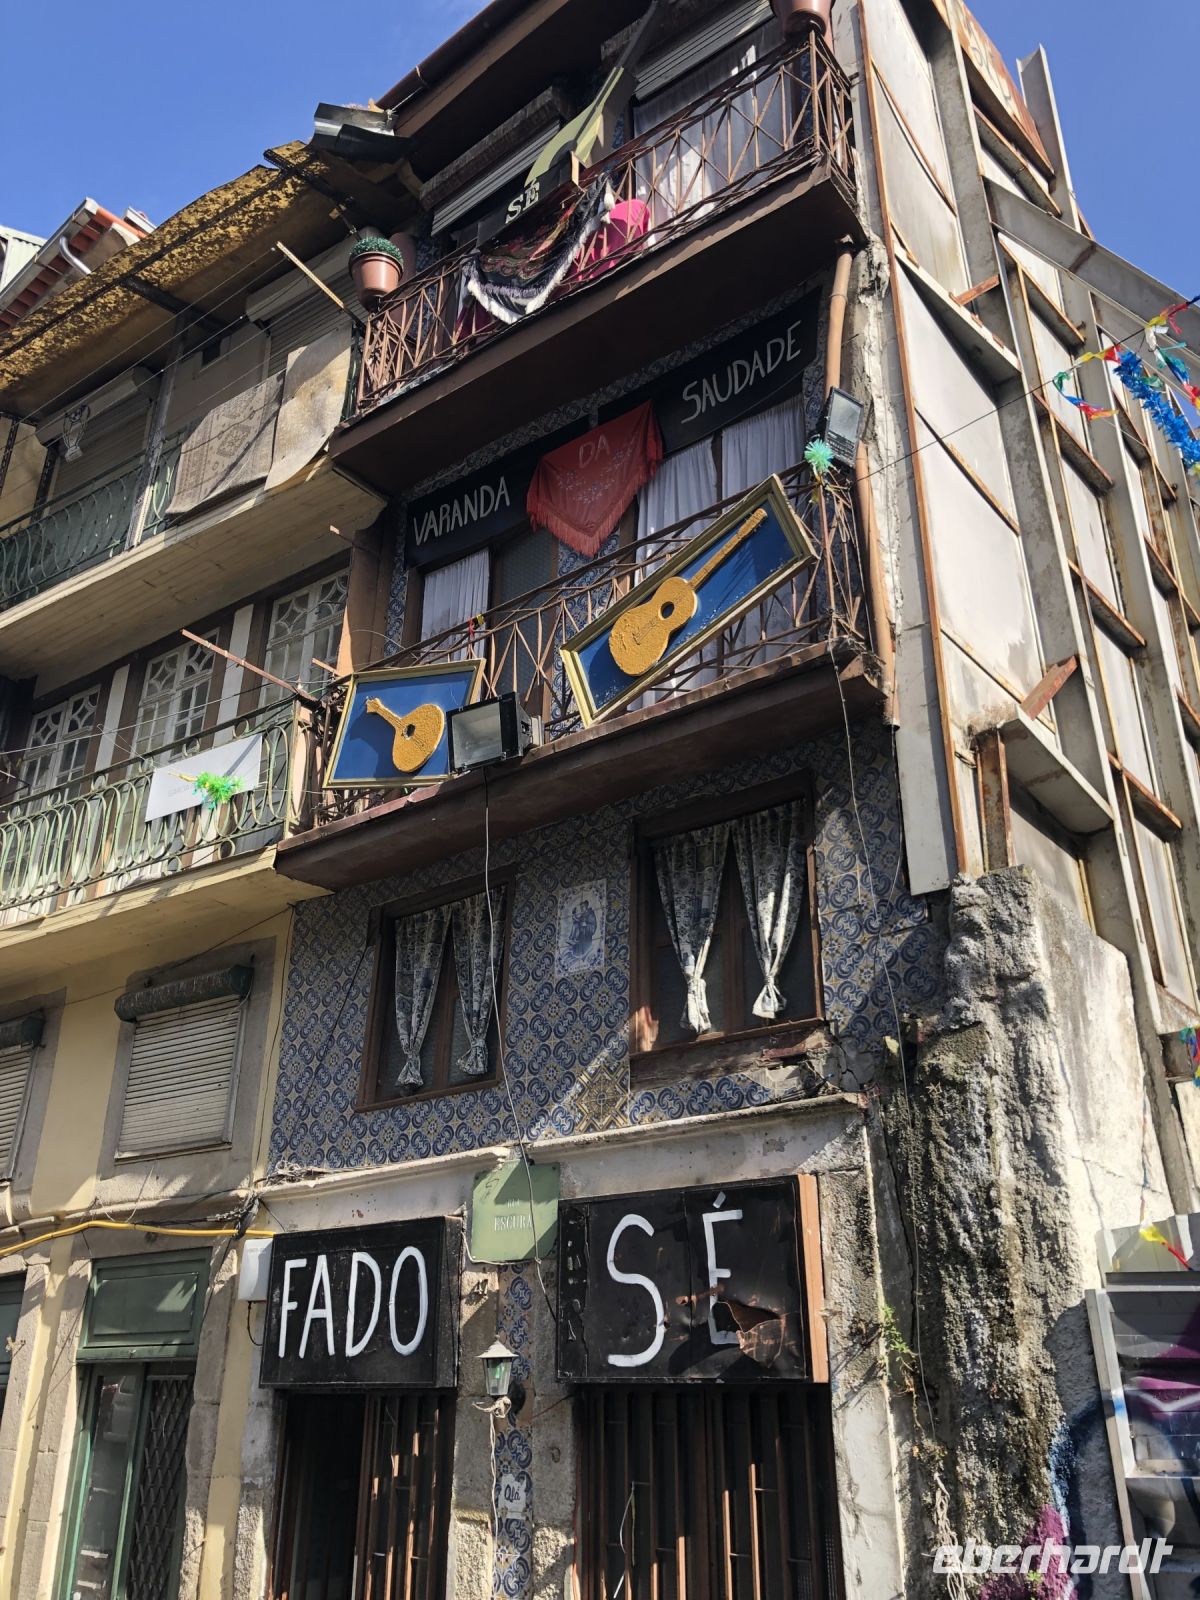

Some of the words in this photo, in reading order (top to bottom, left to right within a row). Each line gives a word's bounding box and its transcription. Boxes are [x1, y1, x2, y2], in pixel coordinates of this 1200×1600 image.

[413, 475, 511, 547] VARANDA
[578, 434, 610, 469] DA
[680, 319, 802, 424] SAUDADE
[278, 1245, 429, 1359] FADO
[606, 1190, 744, 1368] SÉ
